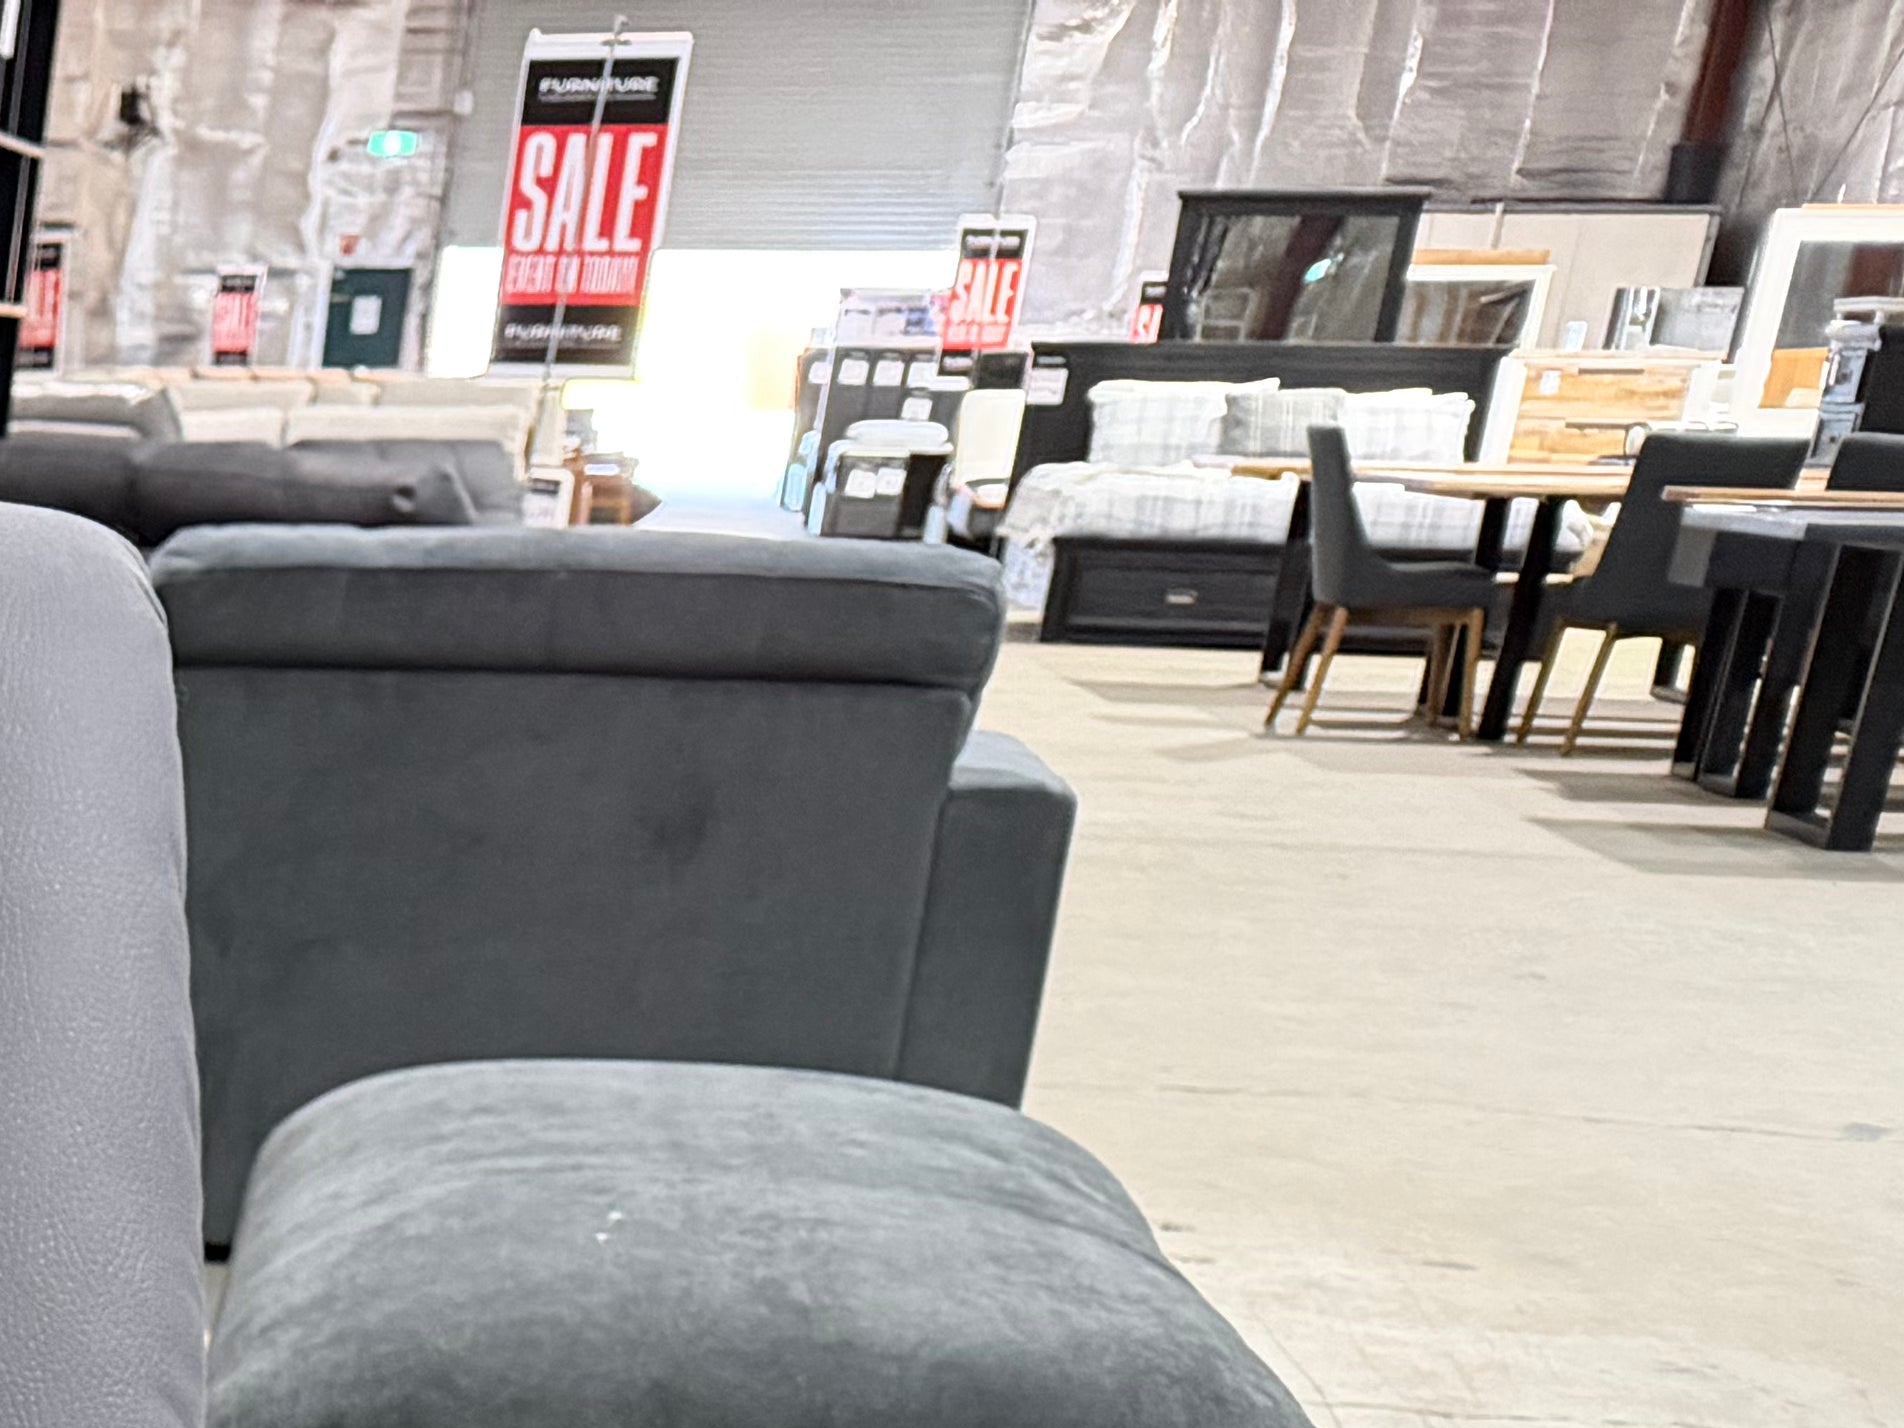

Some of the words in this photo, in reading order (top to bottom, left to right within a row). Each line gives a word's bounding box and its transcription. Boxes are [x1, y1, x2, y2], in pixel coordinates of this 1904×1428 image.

[538, 75, 660, 93] FURNTURE
[511, 131, 658, 252] SALE
[949, 261, 1019, 323] SALE
